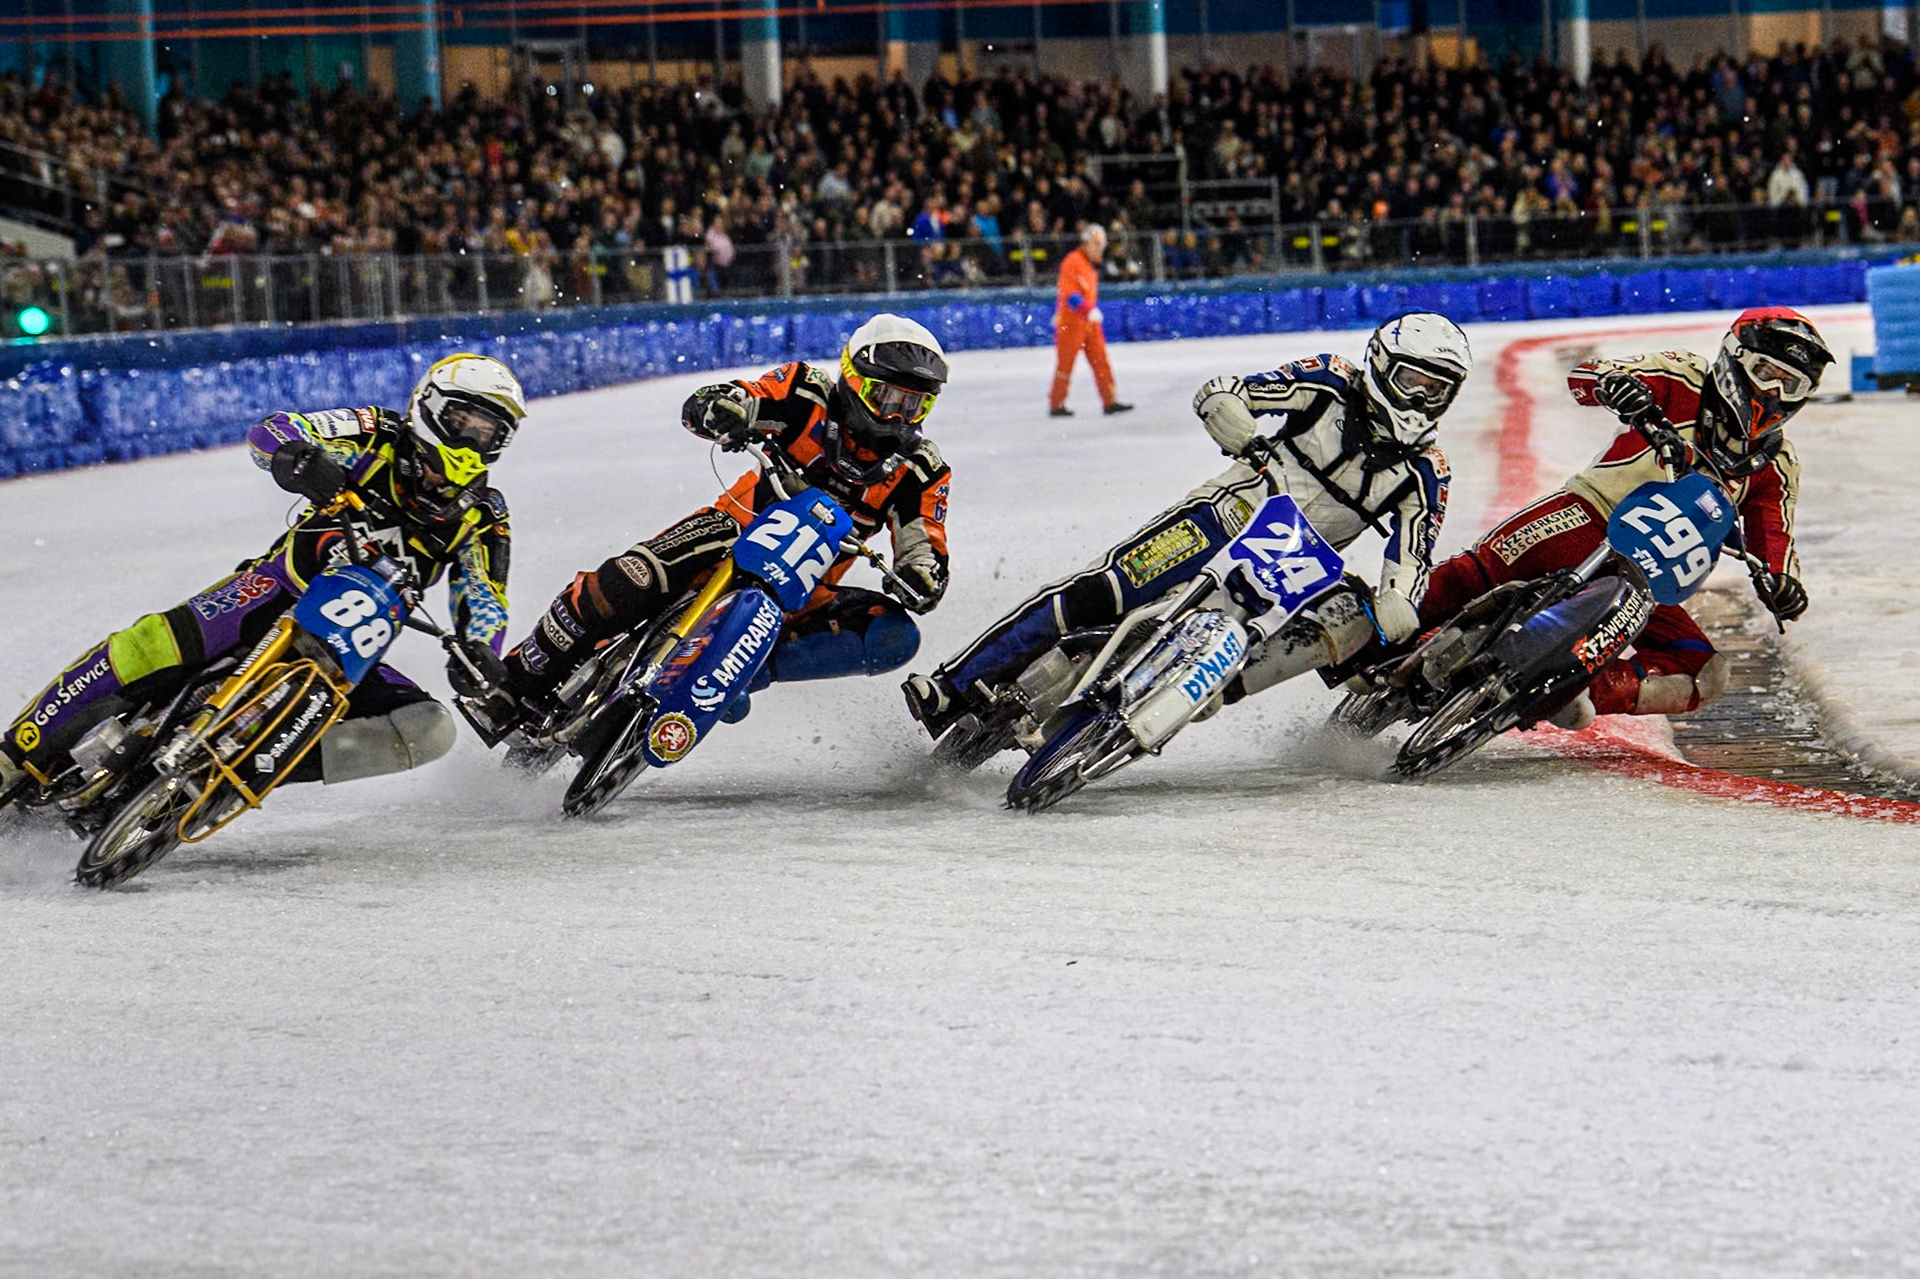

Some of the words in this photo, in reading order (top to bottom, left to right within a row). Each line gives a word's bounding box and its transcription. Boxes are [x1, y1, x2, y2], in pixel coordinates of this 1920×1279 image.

[746, 509, 834, 593] 212
[1240, 522, 1328, 594] 24
[1503, 532, 1541, 562] POSCH
[1544, 513, 1589, 535] MARTIN
[1620, 493, 1711, 587] 299
[1632, 547, 1663, 578] FIM
[627, 558, 648, 579] JAWA
[763, 561, 790, 585] FIM
[320, 590, 392, 659] 88
